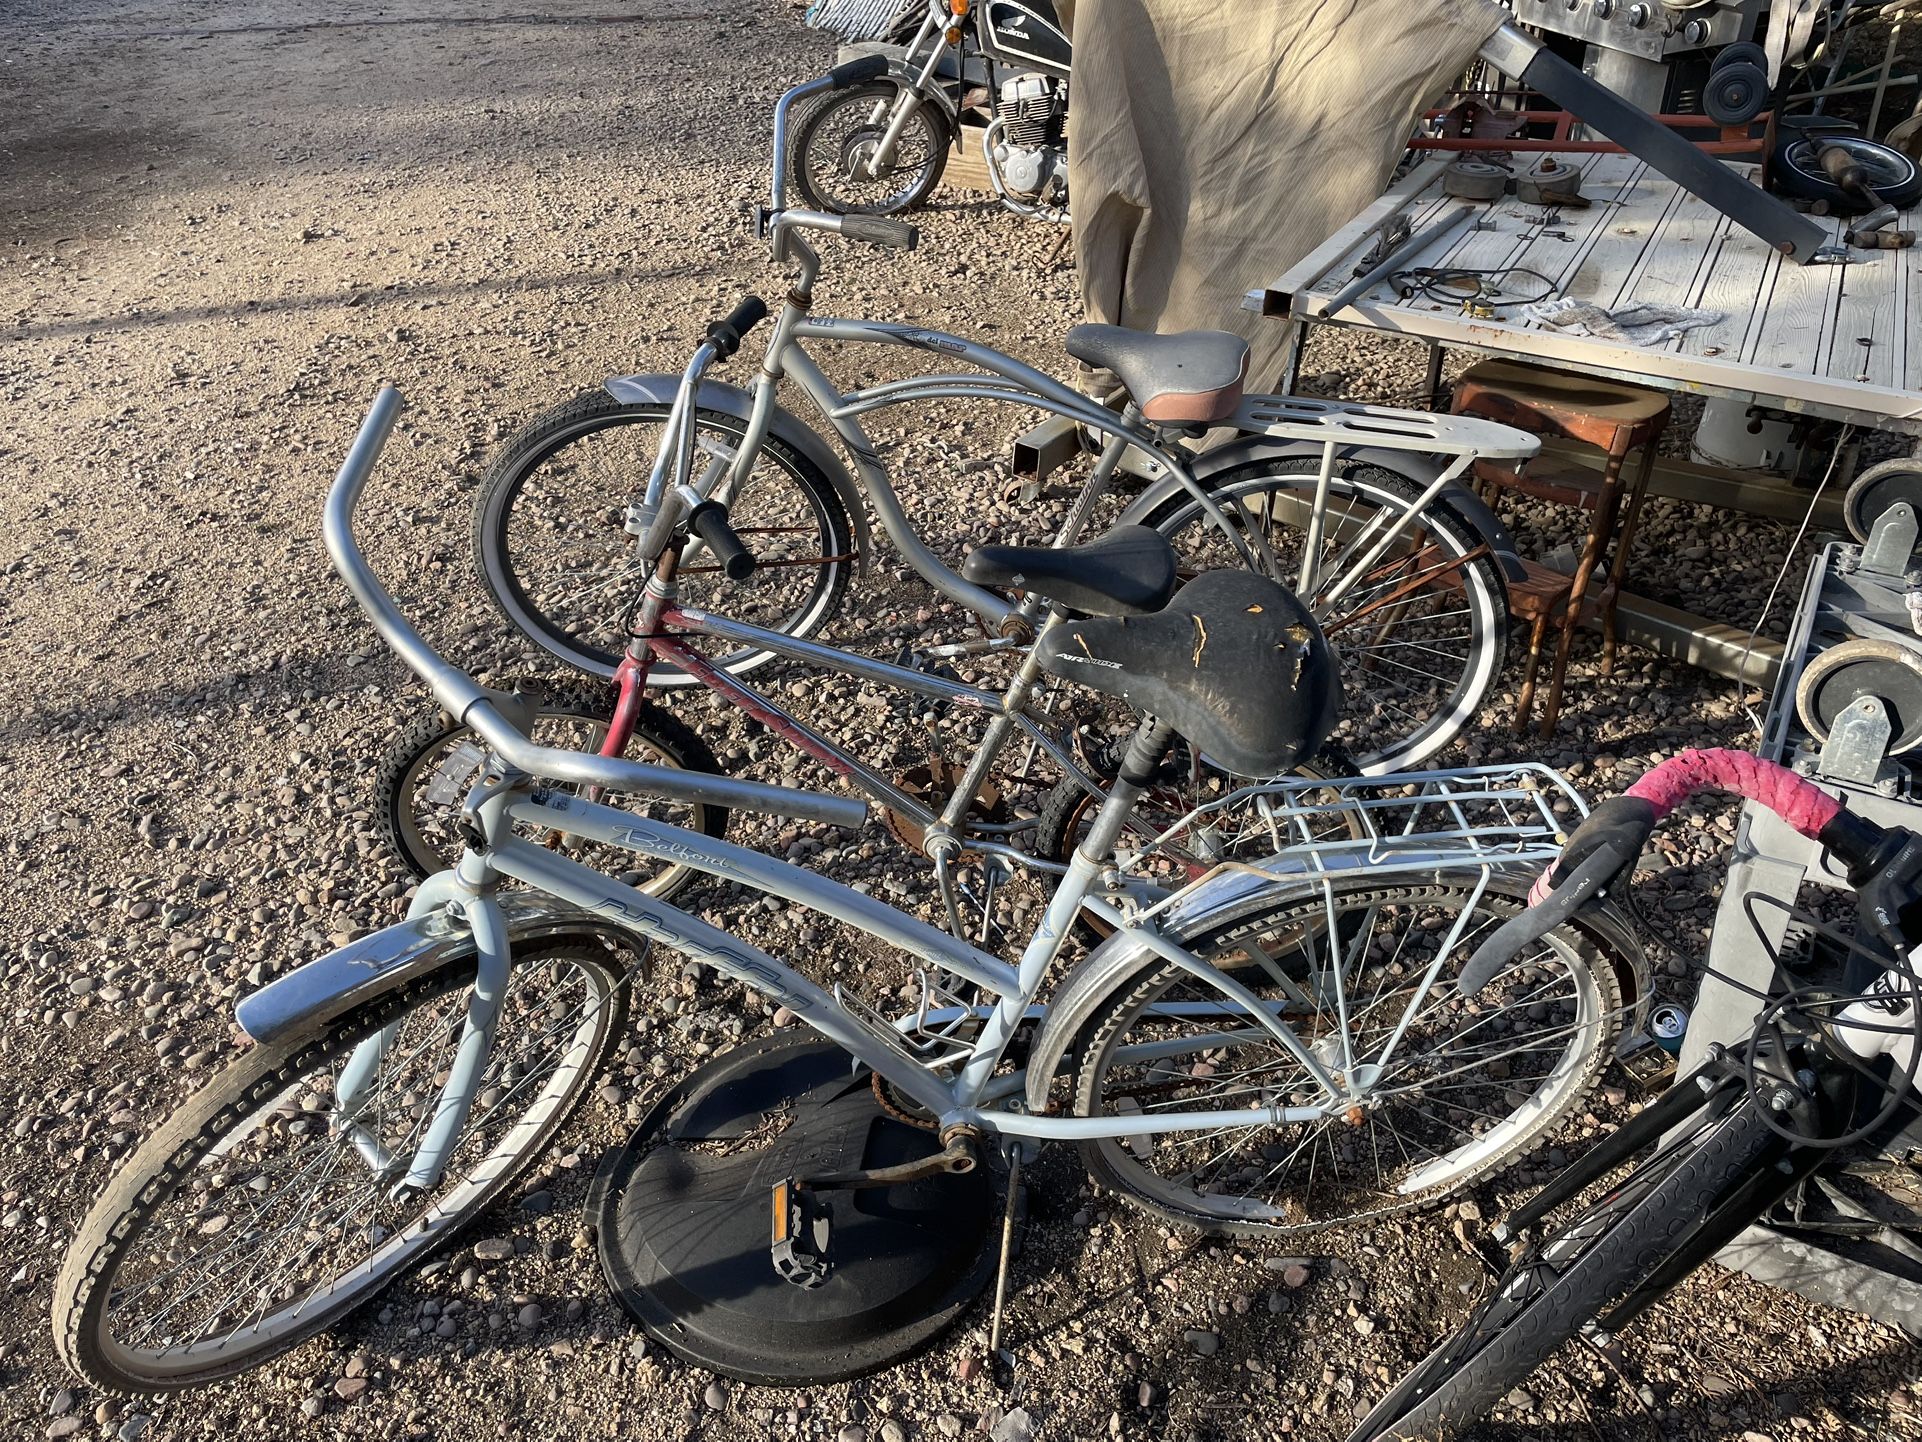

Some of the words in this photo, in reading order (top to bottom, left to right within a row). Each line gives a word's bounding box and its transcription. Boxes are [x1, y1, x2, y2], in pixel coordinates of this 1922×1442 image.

[996, 26, 1030, 40] HONDA
[1061, 473, 1098, 545] Schwinn
[1886, 846, 1915, 878] SHIMO
